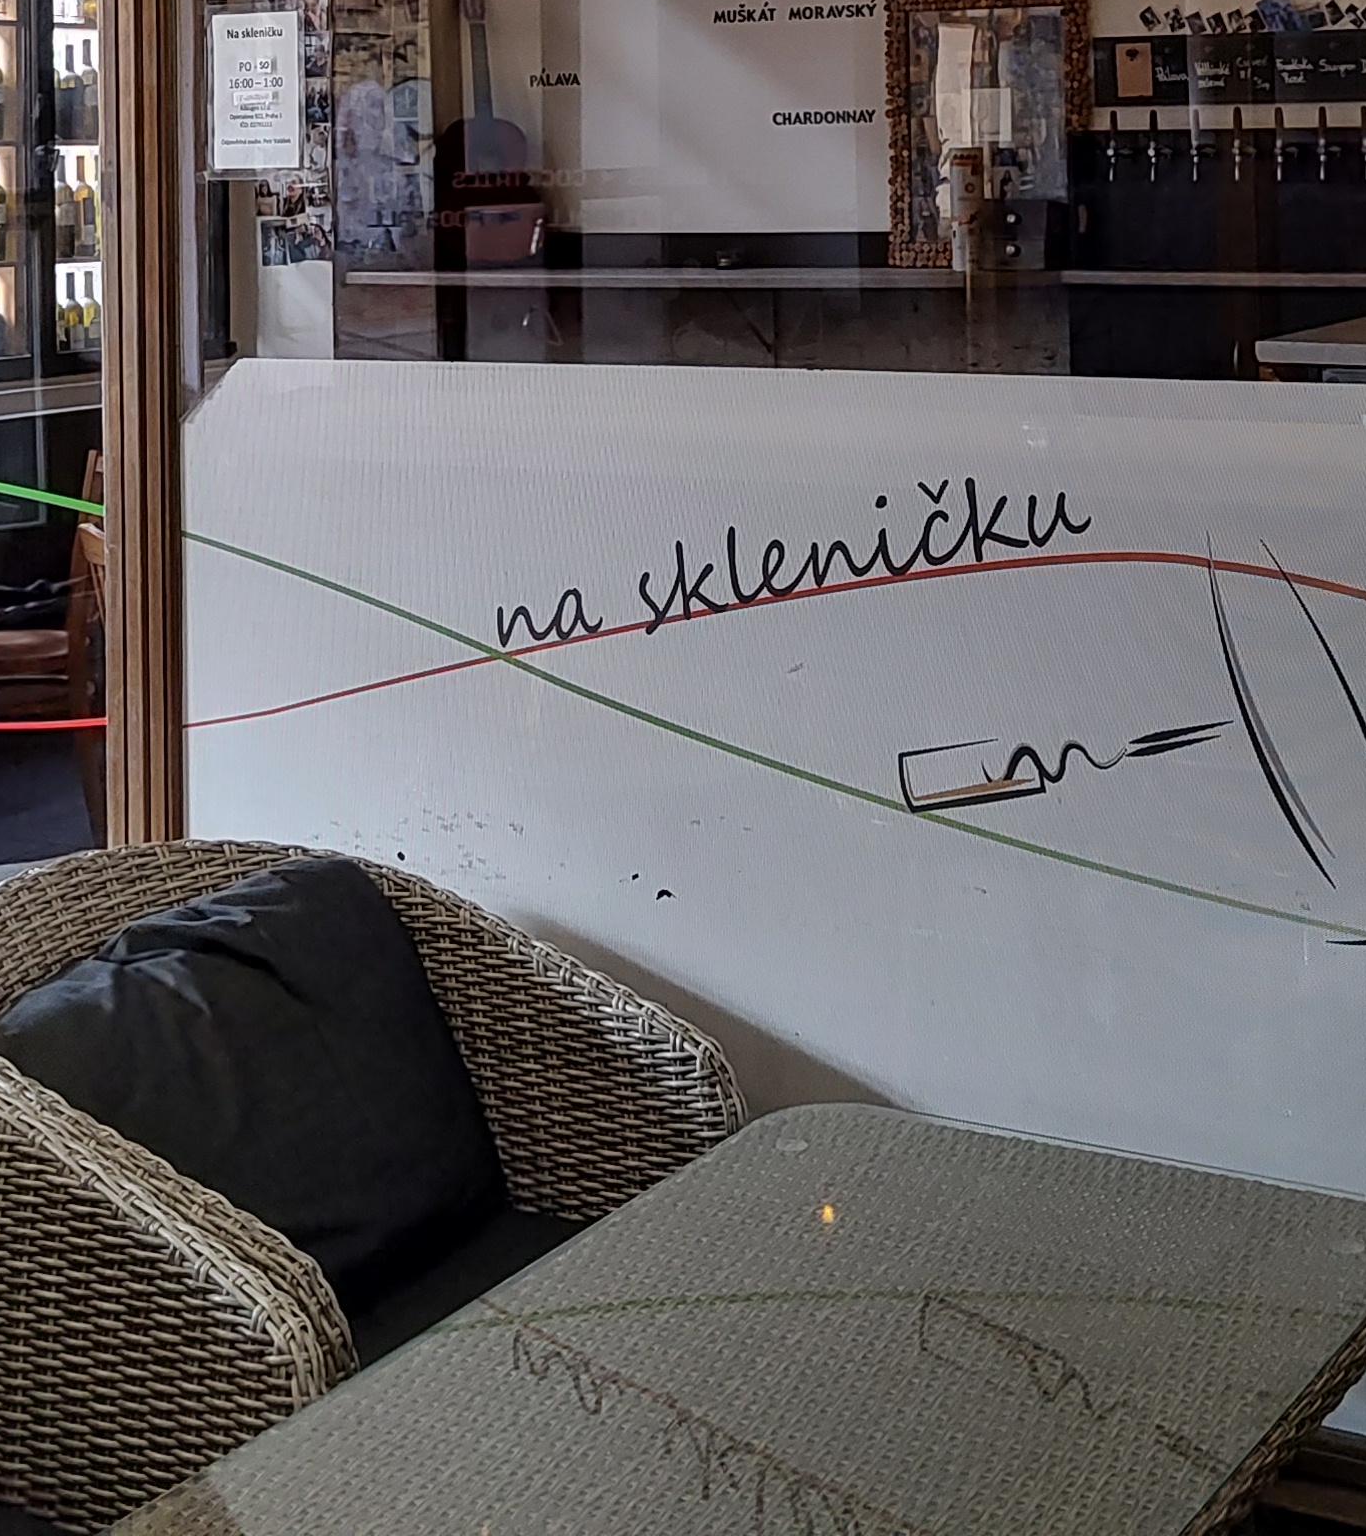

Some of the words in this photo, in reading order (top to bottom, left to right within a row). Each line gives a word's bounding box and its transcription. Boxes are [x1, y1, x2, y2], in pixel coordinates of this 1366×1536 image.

[226, 29, 239, 40] Na
[241, 26, 283, 39] skleničku
[238, 61, 252, 72] PO
[229, 78, 254, 89] 16:00
[263, 76, 284, 88] 1:00
[529, 67, 581, 88] PÁLAVA
[772, 109, 877, 126] CHARDONNAY
[496, 587, 602, 647] na
[638, 477, 1092, 635] skleničku
